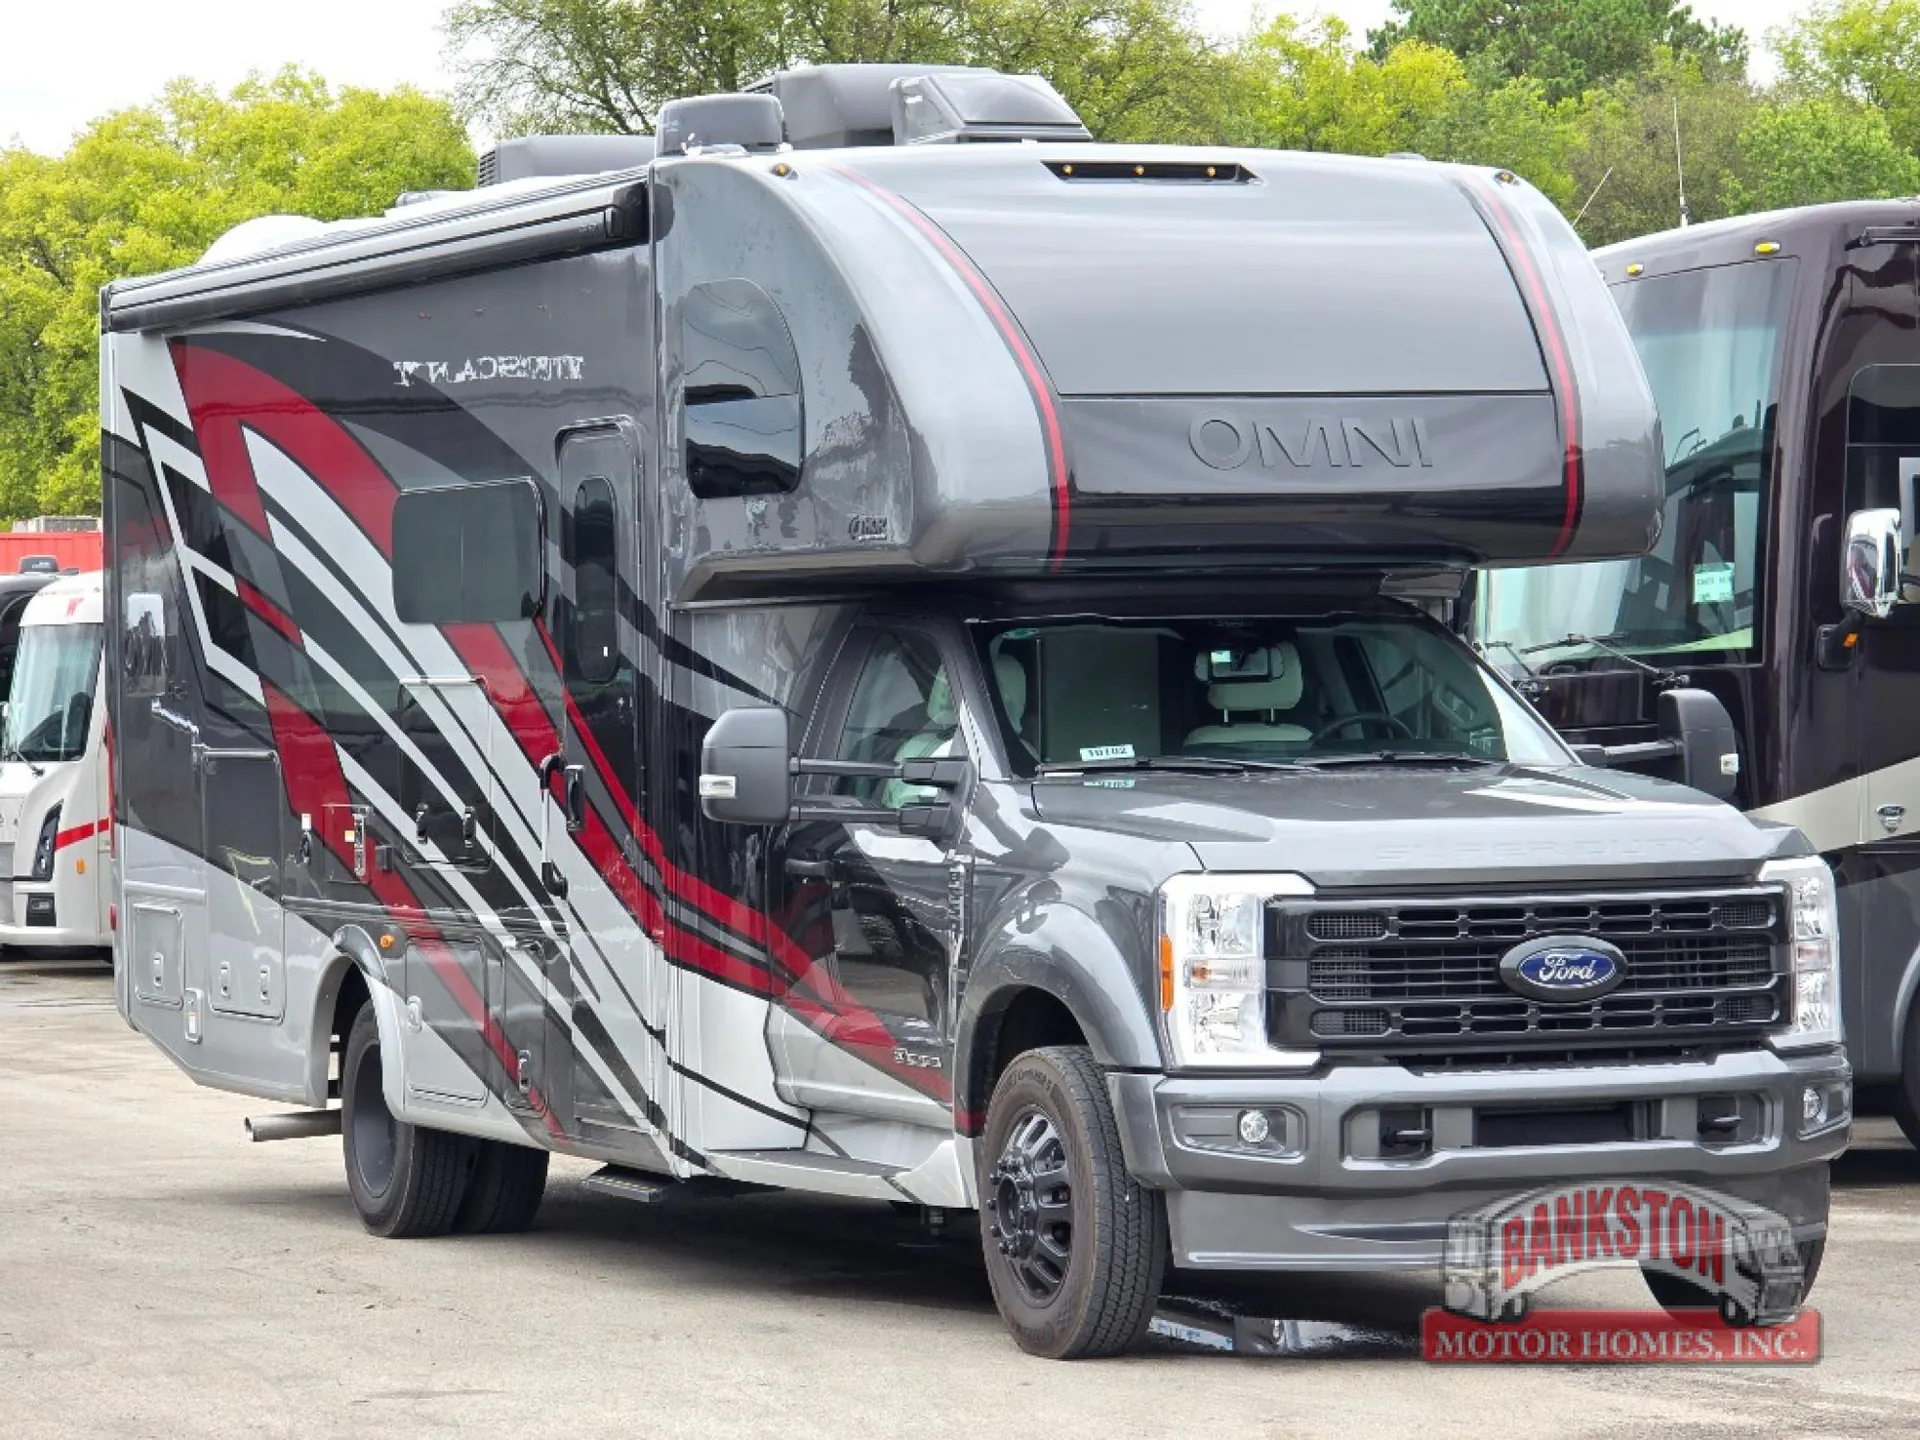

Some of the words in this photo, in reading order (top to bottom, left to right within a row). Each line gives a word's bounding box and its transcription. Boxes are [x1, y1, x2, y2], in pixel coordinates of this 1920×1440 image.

[1188, 411, 1433, 471] OMNI
[1374, 840, 1566, 860] SUPER
[1574, 837, 1706, 855] DUTY
[1538, 953, 1598, 982] Ford
